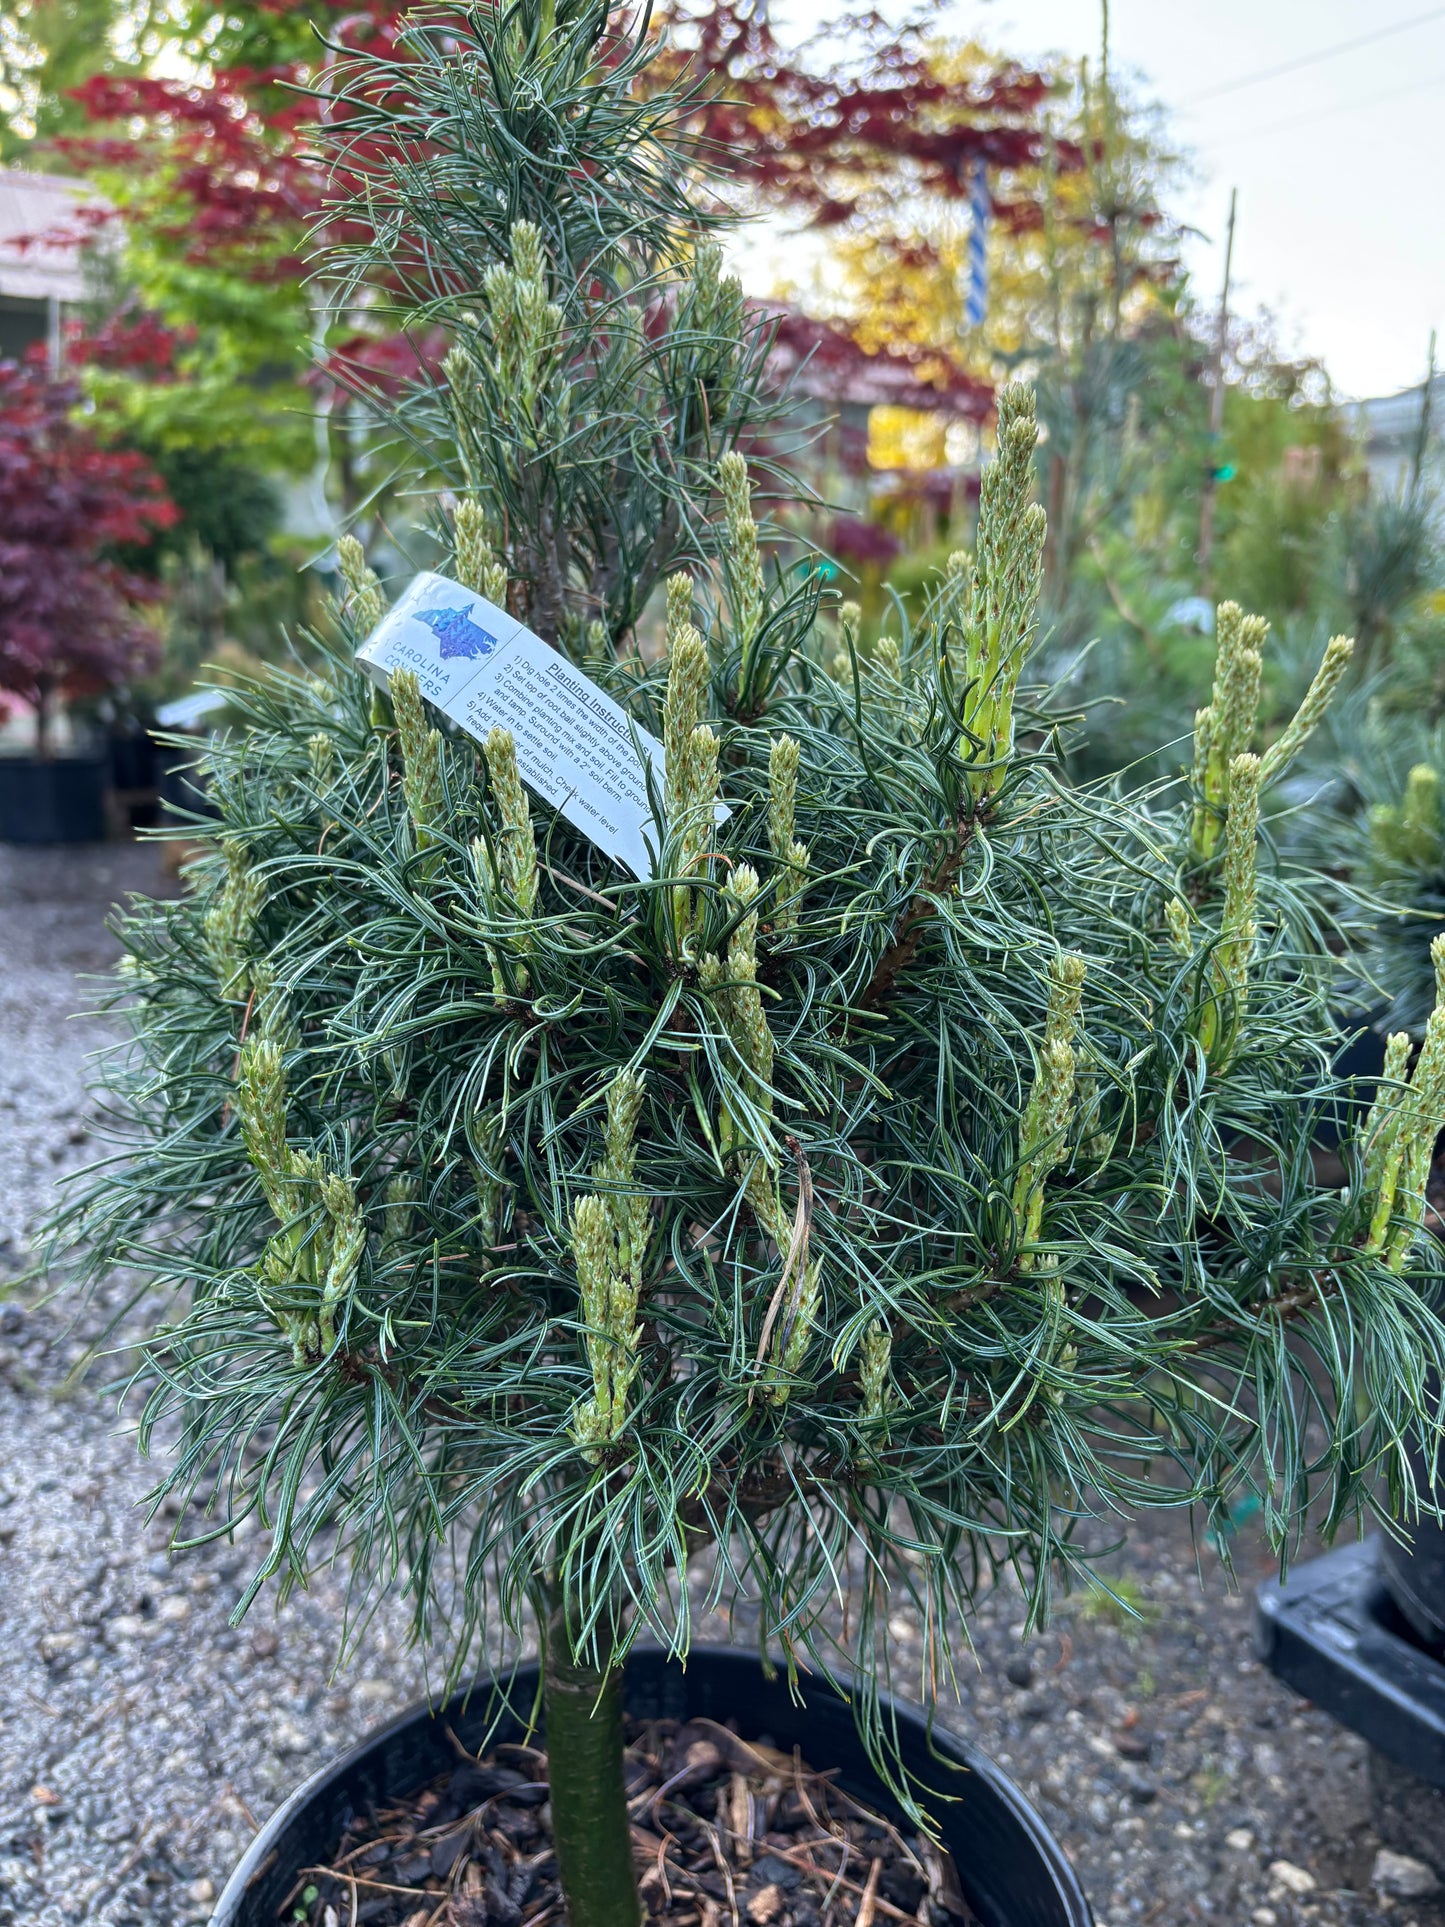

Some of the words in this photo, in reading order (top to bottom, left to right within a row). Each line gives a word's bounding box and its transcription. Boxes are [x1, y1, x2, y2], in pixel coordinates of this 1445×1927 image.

[384, 654, 442, 696] COERS
[392, 641, 450, 684] CAROLINA
[514, 655, 523, 665] 1)
[521, 661, 535, 675] Dig
[534, 671, 550, 687] hole
[550, 685, 558, 693] 2
[556, 690, 576, 710] times
[576, 707, 589, 720] the
[588, 721, 609, 739] width
[608, 737, 617, 746] of
[616, 743, 629, 757] the
[548, 663, 590, 703] Planting
[589, 698, 649, 754] Instructis
[477, 691, 487, 701] 4)
[485, 697, 508, 717] Water
[506, 715, 515, 725] in
[514, 722, 524, 731] to
[522, 729, 544, 749] settle
[542, 747, 559, 763] soil.
[493, 688, 511, 702] and
[508, 699, 527, 718] tamp.
[528, 716, 560, 745] Suround
[559, 742, 575, 758] with
[573, 756, 581, 764] a
[588, 770, 605, 785] soil
[602, 782, 623, 804] berm.
[494, 672, 504, 684] 3)
[503, 679, 534, 707] Combine
[532, 706, 563, 734] planting
[561, 730, 577, 745] mix
[574, 742, 592, 757] and
[589, 755, 606, 771] soil.
[605, 768, 620, 783] Fill
[617, 780, 627, 790] to
[503, 663, 514, 674] 2)
[512, 670, 526, 684] Set
[525, 681, 538, 694] top
[537, 691, 548, 700] of
[544, 699, 562, 713] root
[560, 710, 576, 726] ball
[573, 723, 600, 748] slightly
[598, 746, 622, 768] above
[466, 700, 477, 711] 5)
[475, 708, 492, 722] Add
[523, 748, 534, 757] of
[530, 755, 554, 779] mulch.
[578, 798, 600, 818] water
[598, 815, 619, 835] level
[516, 758, 558, 798] established.
